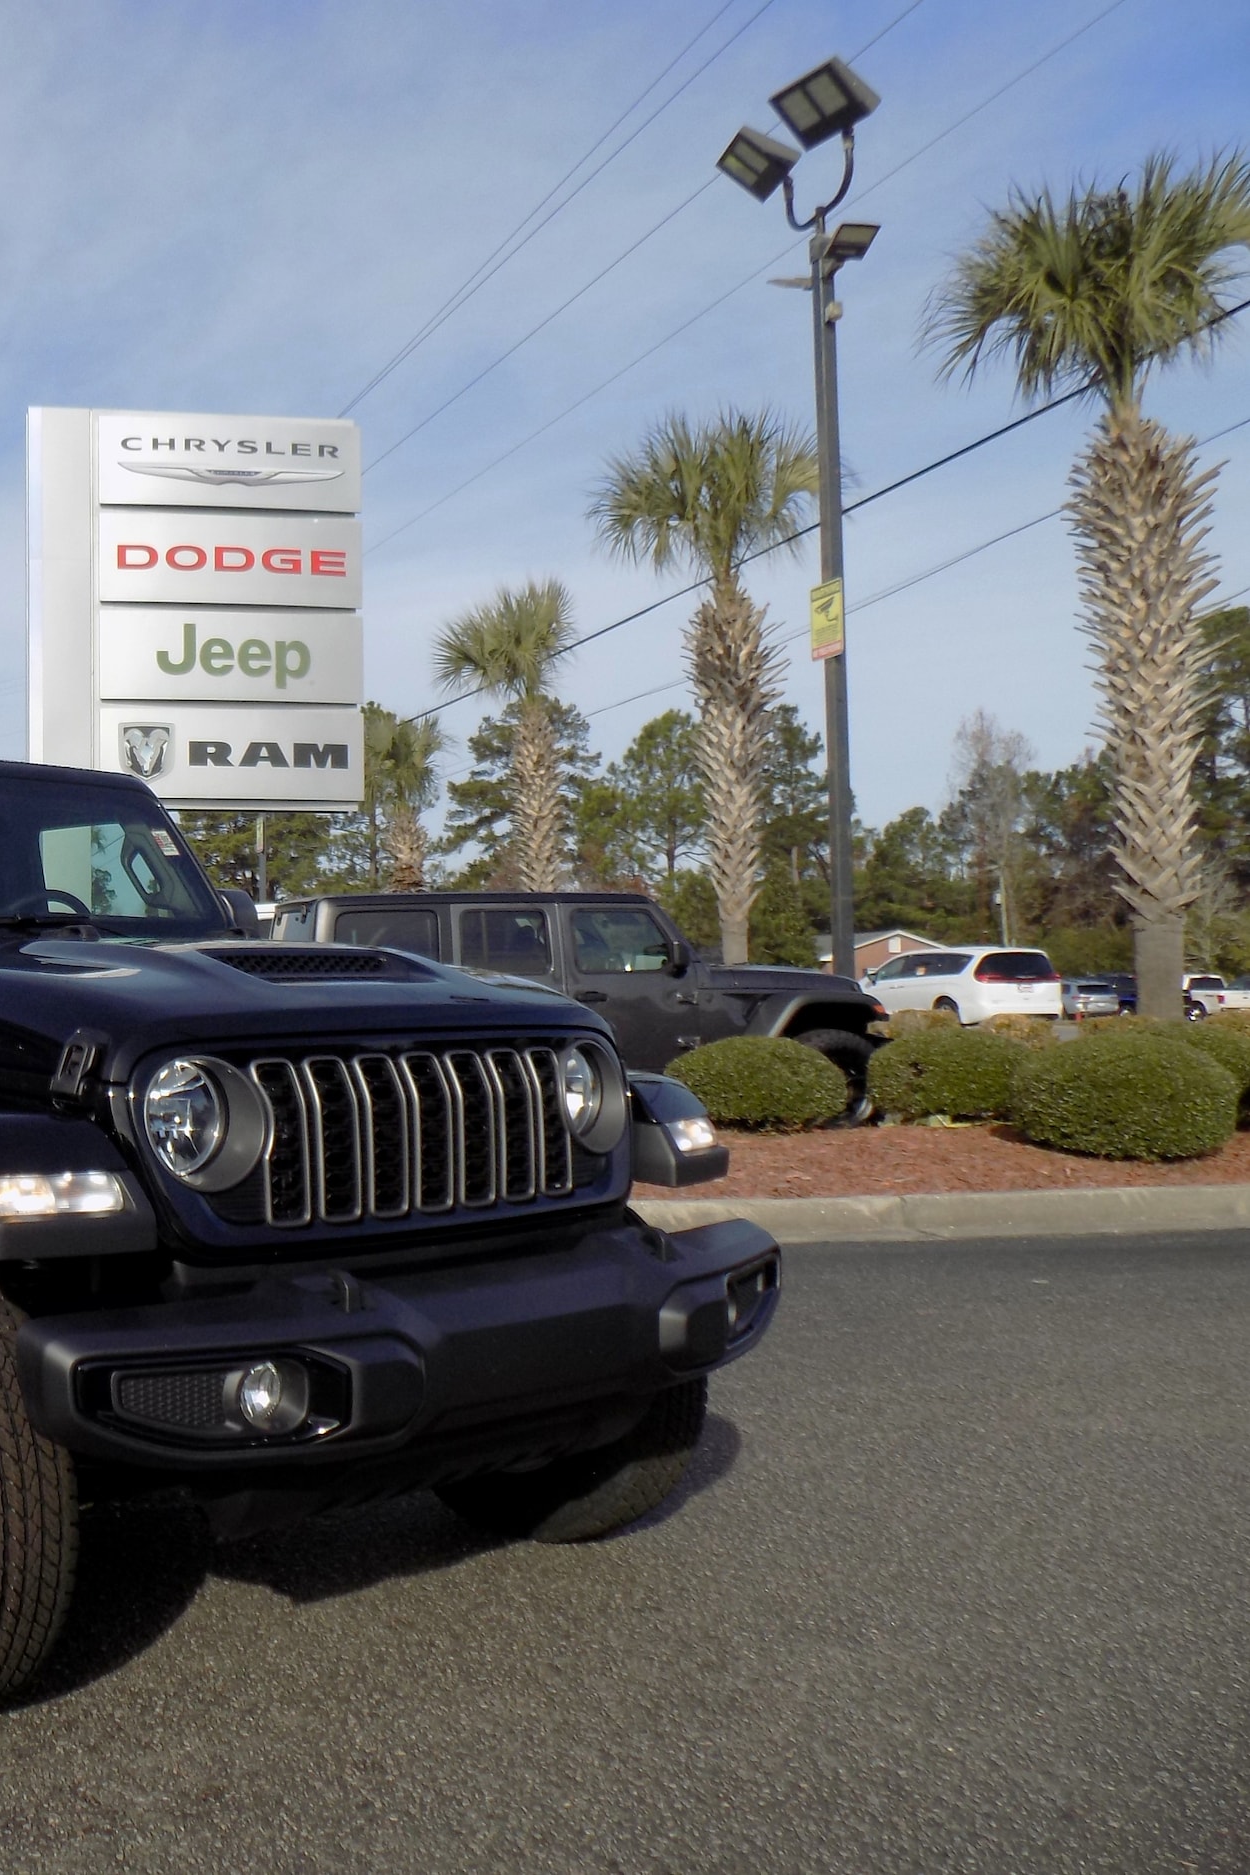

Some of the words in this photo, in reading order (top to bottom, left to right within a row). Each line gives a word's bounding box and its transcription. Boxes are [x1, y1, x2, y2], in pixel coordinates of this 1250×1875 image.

[120, 437, 340, 459] CHRYSLER
[116, 544, 347, 577] DODGE
[156, 623, 312, 690] Jeep
[188, 740, 349, 769] RAM
